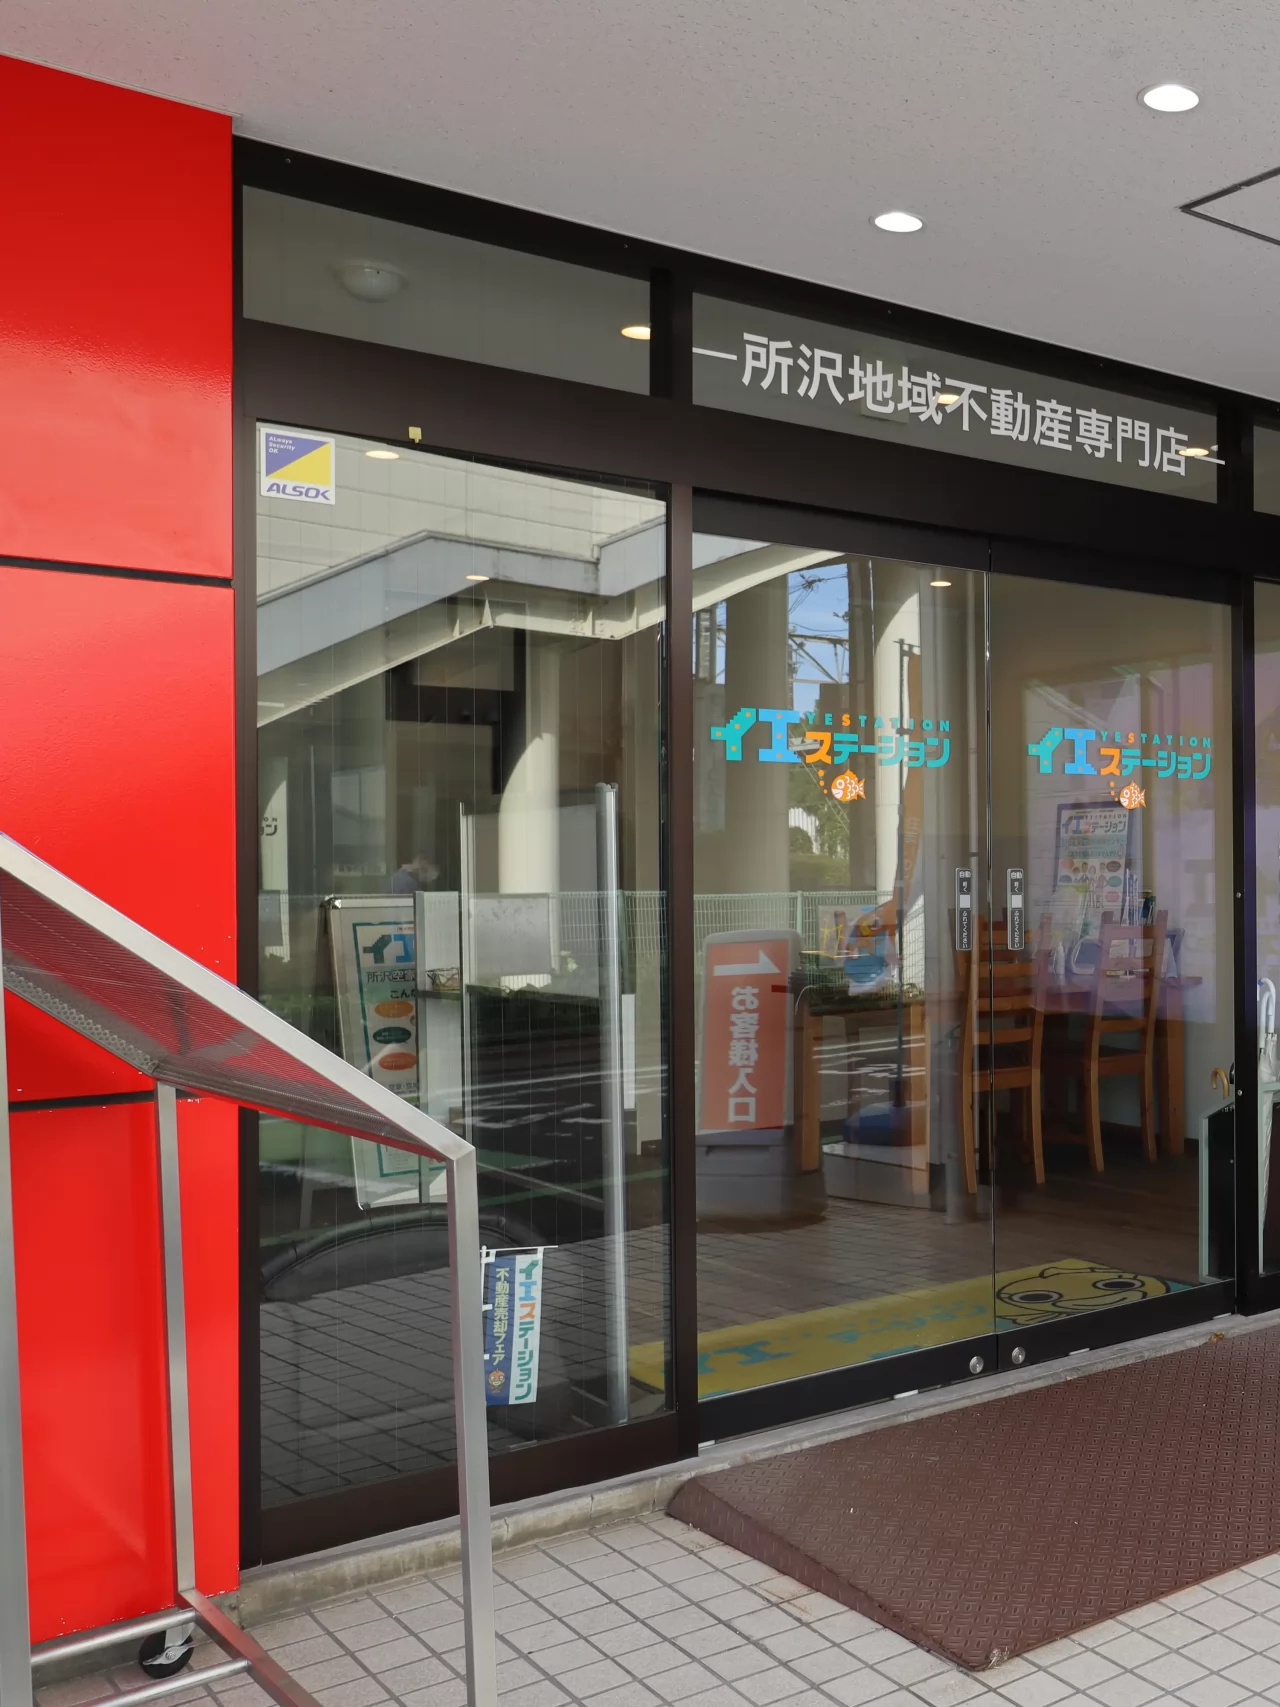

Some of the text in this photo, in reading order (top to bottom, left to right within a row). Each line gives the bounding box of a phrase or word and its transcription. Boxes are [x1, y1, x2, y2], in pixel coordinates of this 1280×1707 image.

[741, 332, 1190, 476] 所沢地域不動産専門店
[268, 442, 296, 451] Security
[266, 482, 331, 501] ALSOK
[806, 712, 951, 732] YESTATION
[1100, 731, 1212, 749] YESTATION
[492, 1267, 510, 1366] 不動産売却フェア
[514, 1259, 539, 1401] イエステーション
